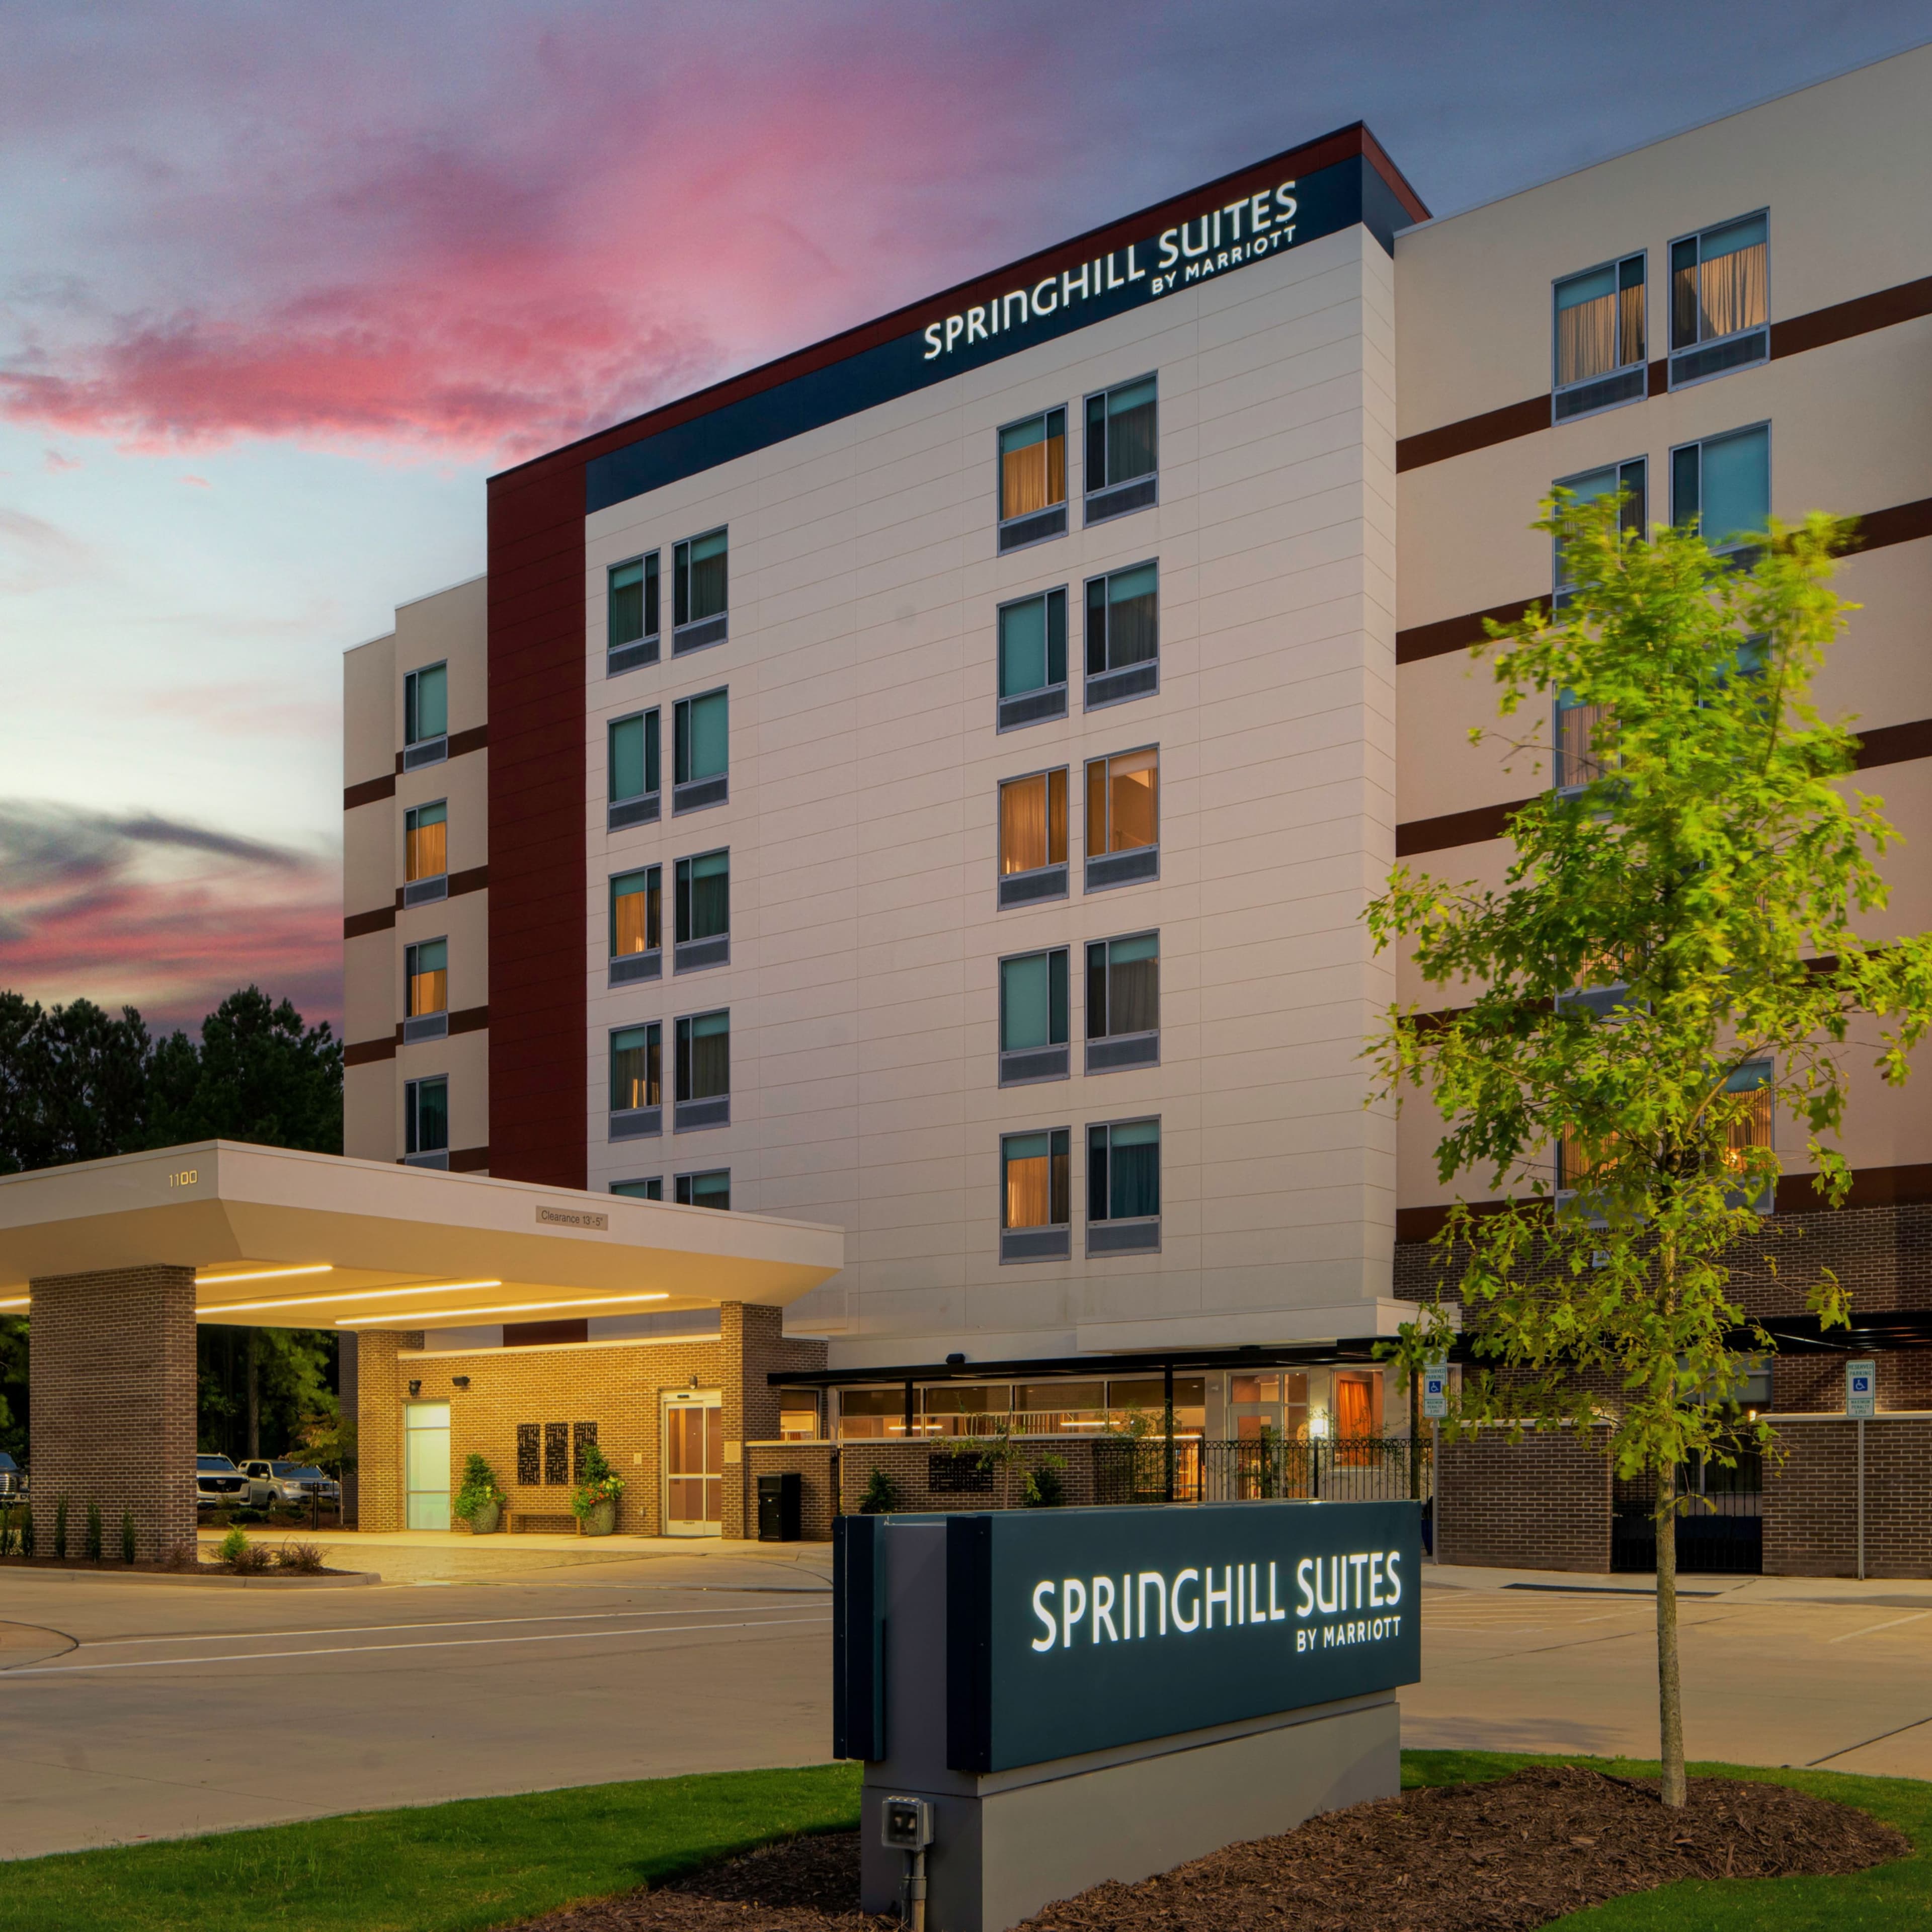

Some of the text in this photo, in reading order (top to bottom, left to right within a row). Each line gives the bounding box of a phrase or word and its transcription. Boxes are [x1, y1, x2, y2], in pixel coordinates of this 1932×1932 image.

[924, 181, 1297, 359] SPRINGHILL SUITES
[1152, 225, 1296, 294] BY MARRIOTT
[169, 1170, 197, 1187] 1100
[541, 1210, 580, 1224] Clearance
[1031, 1551, 1401, 1652] SPRINGHILL SUITES
[1297, 1616, 1401, 1652] BY MARRIOTT
